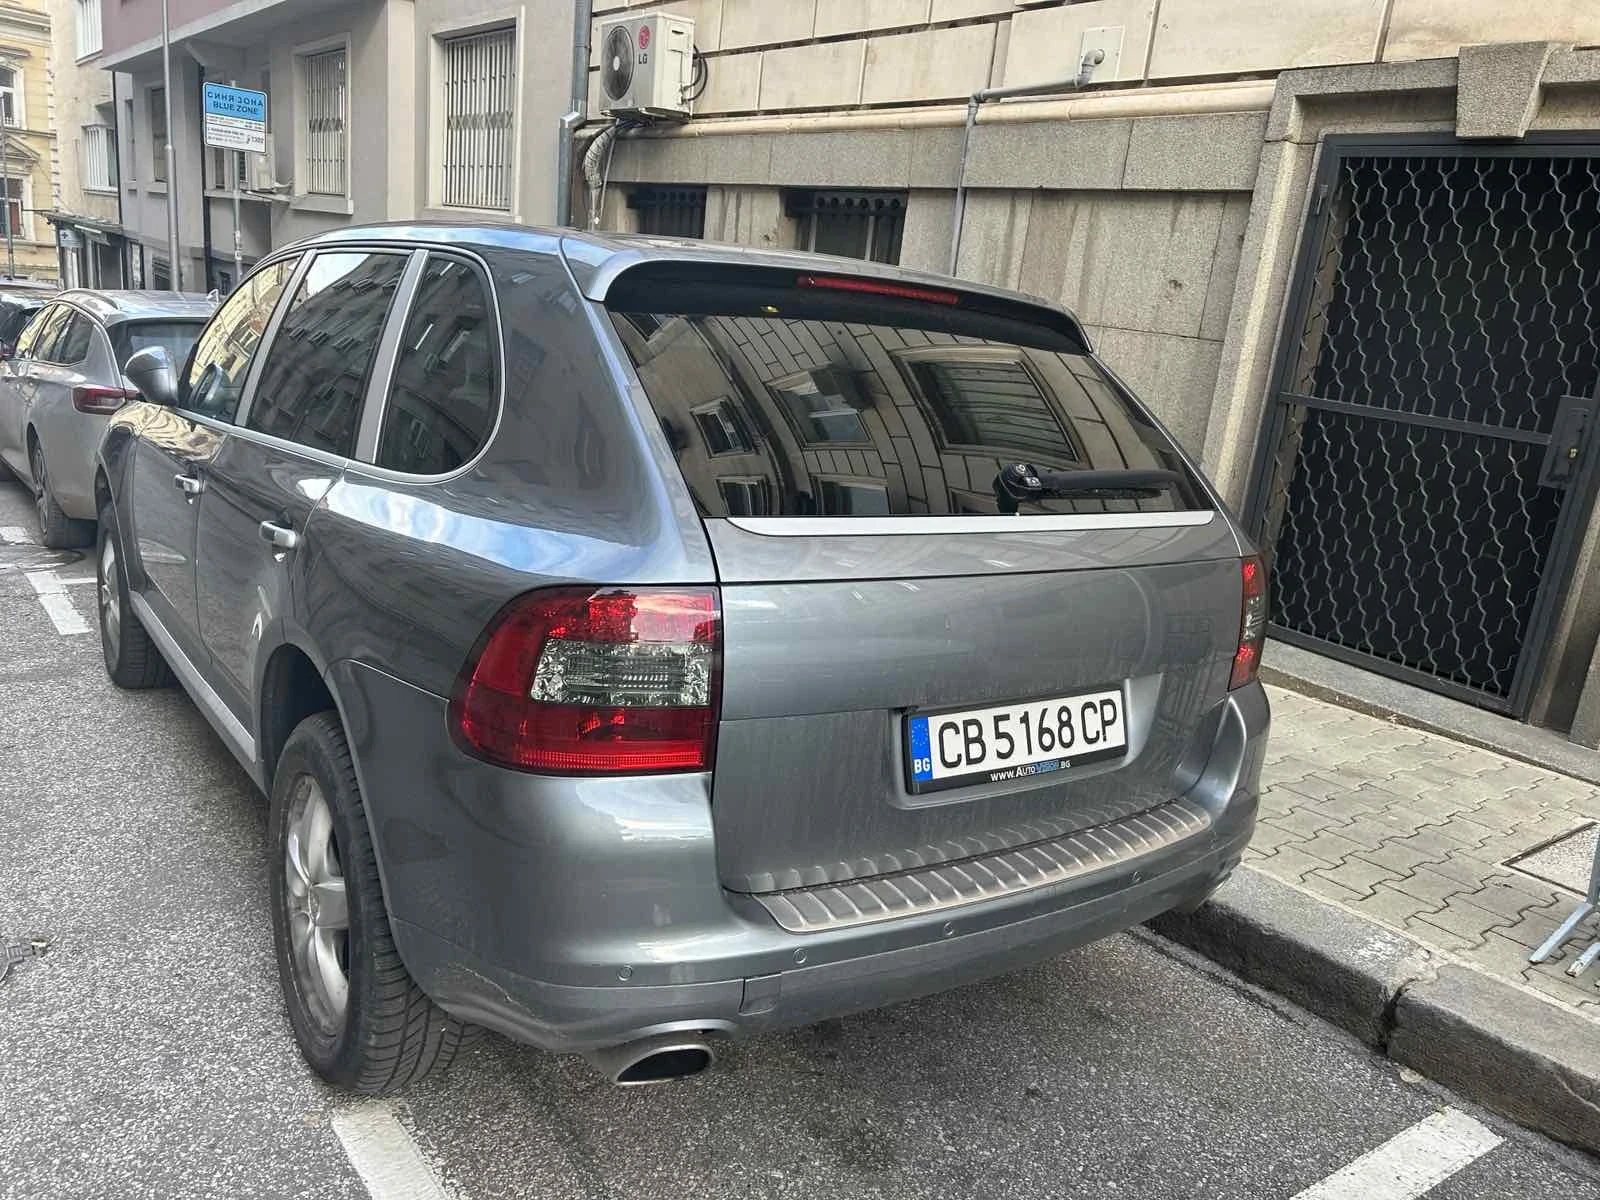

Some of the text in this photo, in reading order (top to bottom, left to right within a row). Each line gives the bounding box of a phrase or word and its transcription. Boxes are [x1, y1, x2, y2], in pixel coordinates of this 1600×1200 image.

[638, 53, 648, 65] LG
[207, 91, 264, 107] СИНЯ ЗОНА
[213, 101, 258, 115] BLUE ZONE
[993, 707, 1075, 760] 5168
[913, 758, 931, 774] BG
